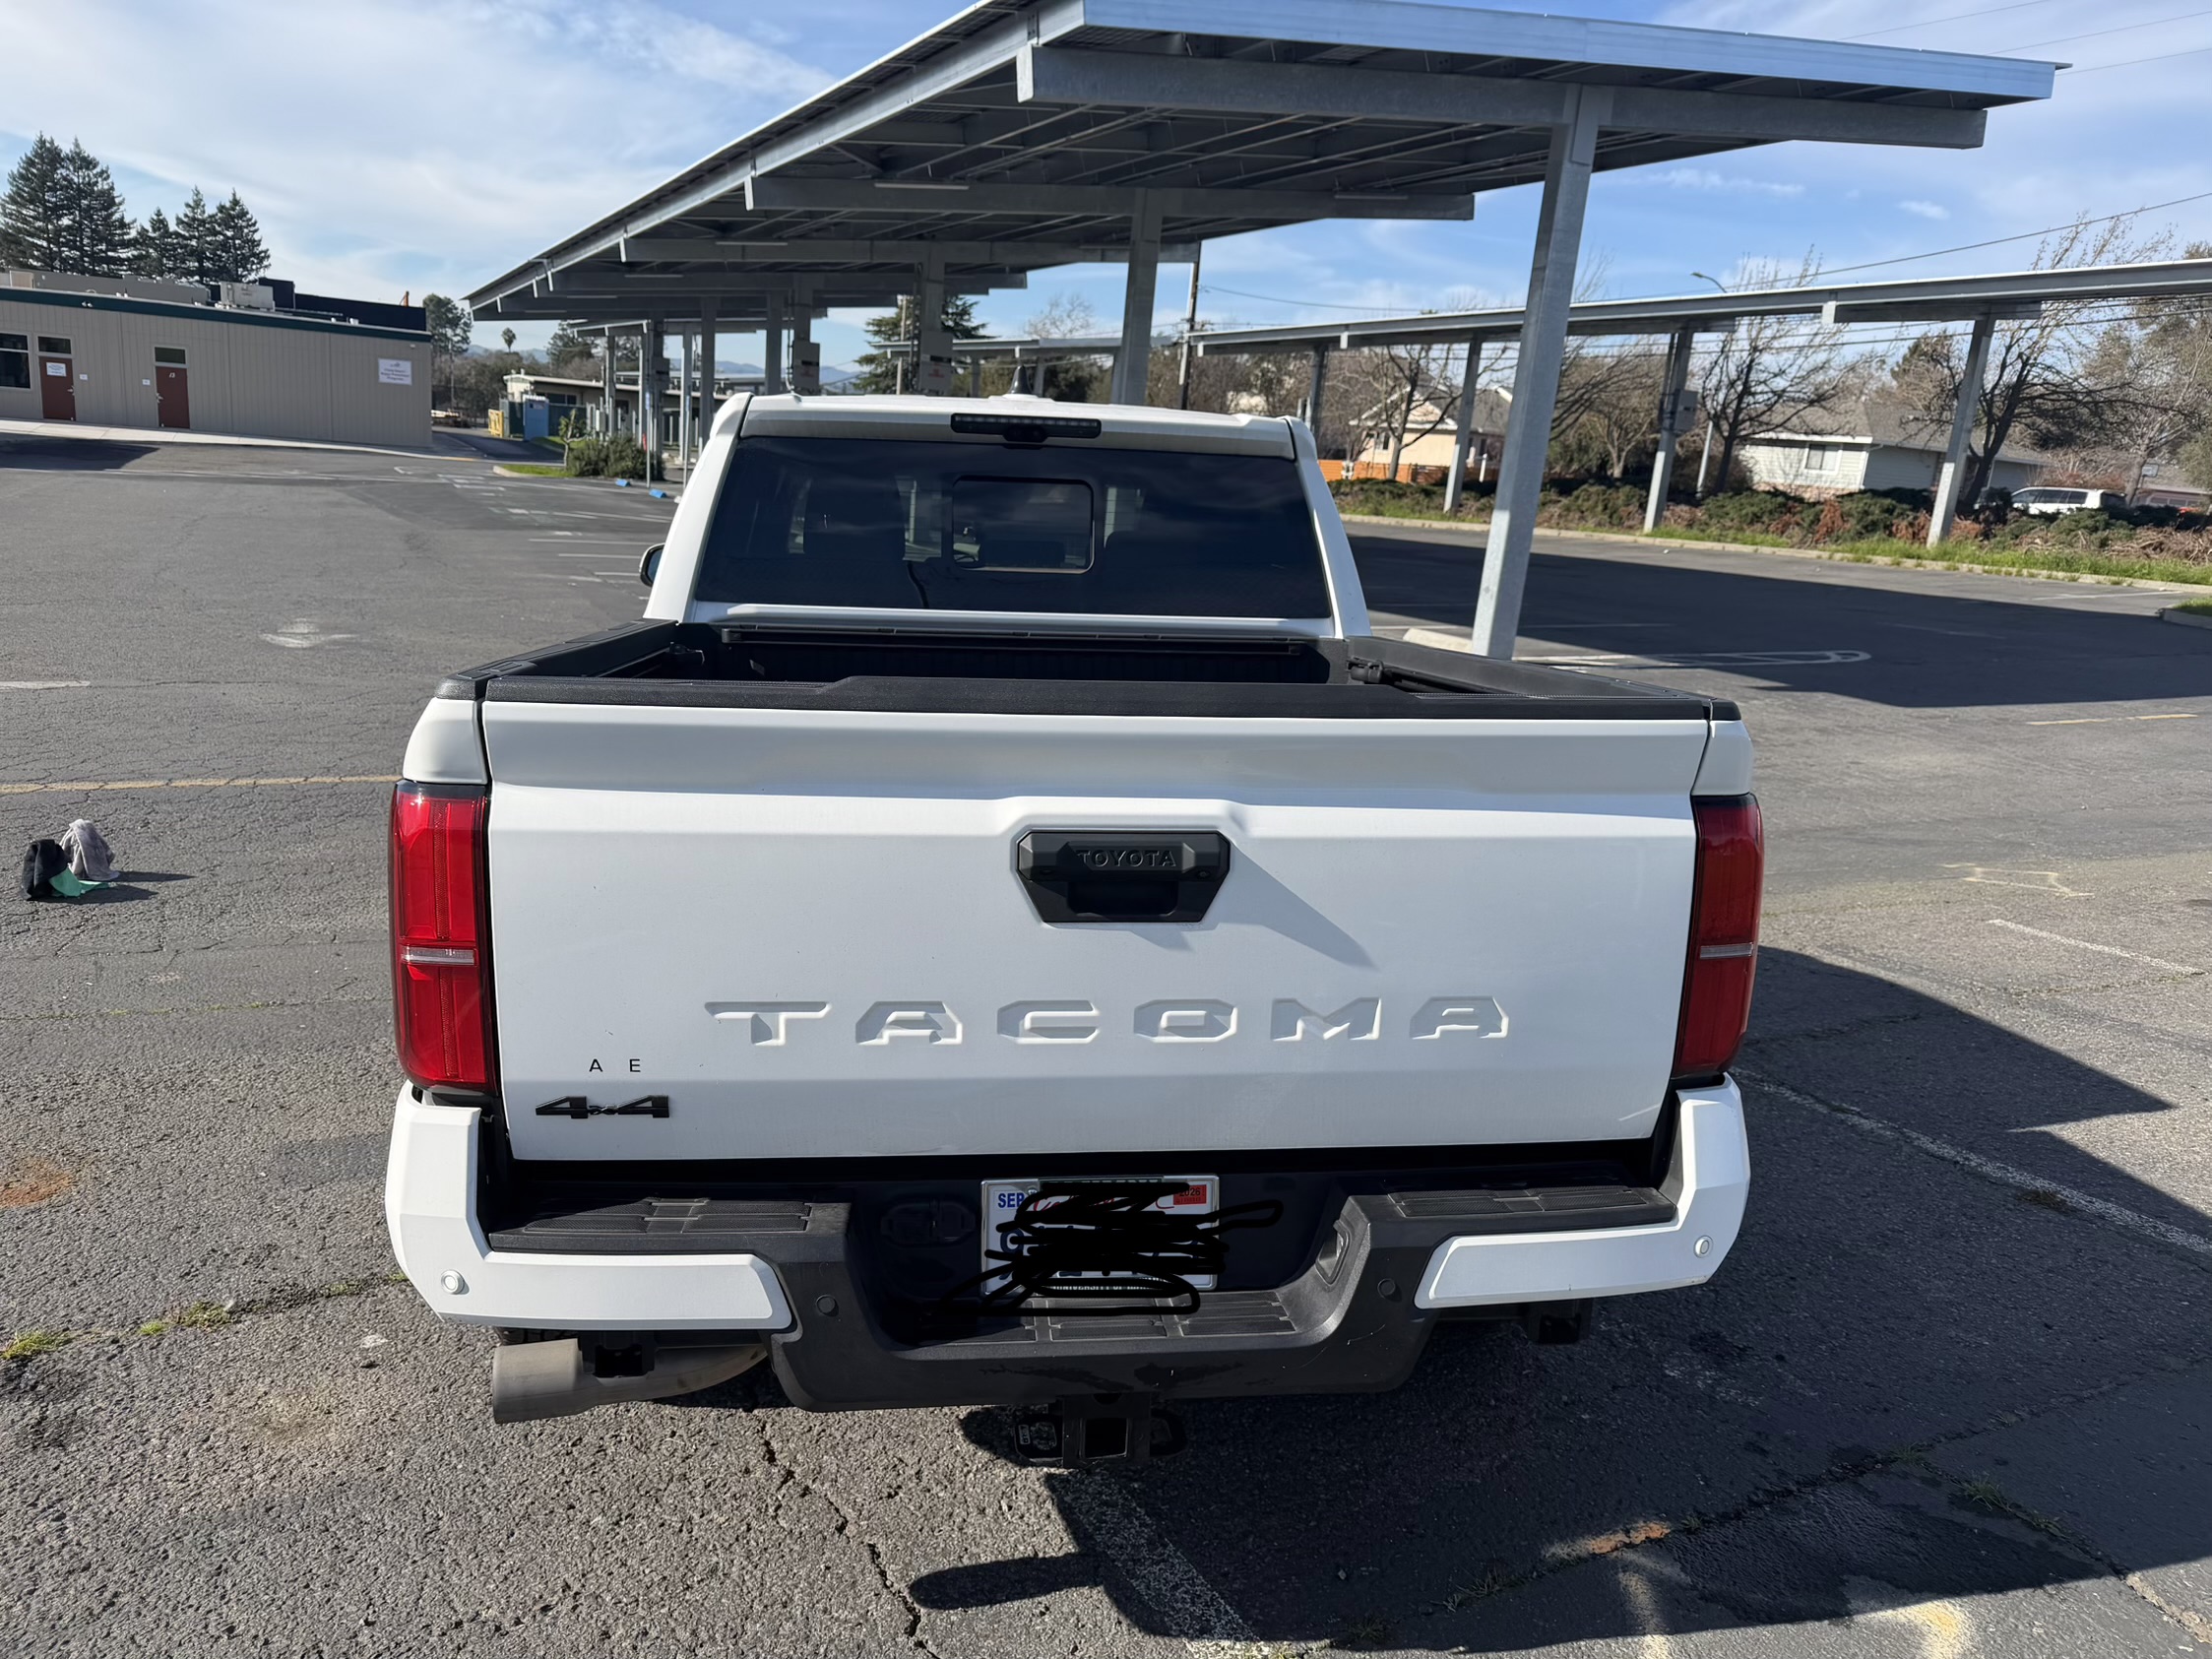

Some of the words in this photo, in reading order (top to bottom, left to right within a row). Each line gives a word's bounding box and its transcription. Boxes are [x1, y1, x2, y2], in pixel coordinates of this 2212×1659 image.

[1077, 850, 1176, 866] TOYOTA
[704, 996, 1510, 1048] TACOMA
[589, 1058, 603, 1072] A
[629, 1058, 641, 1072] E
[997, 1192, 1025, 1208] SEP
